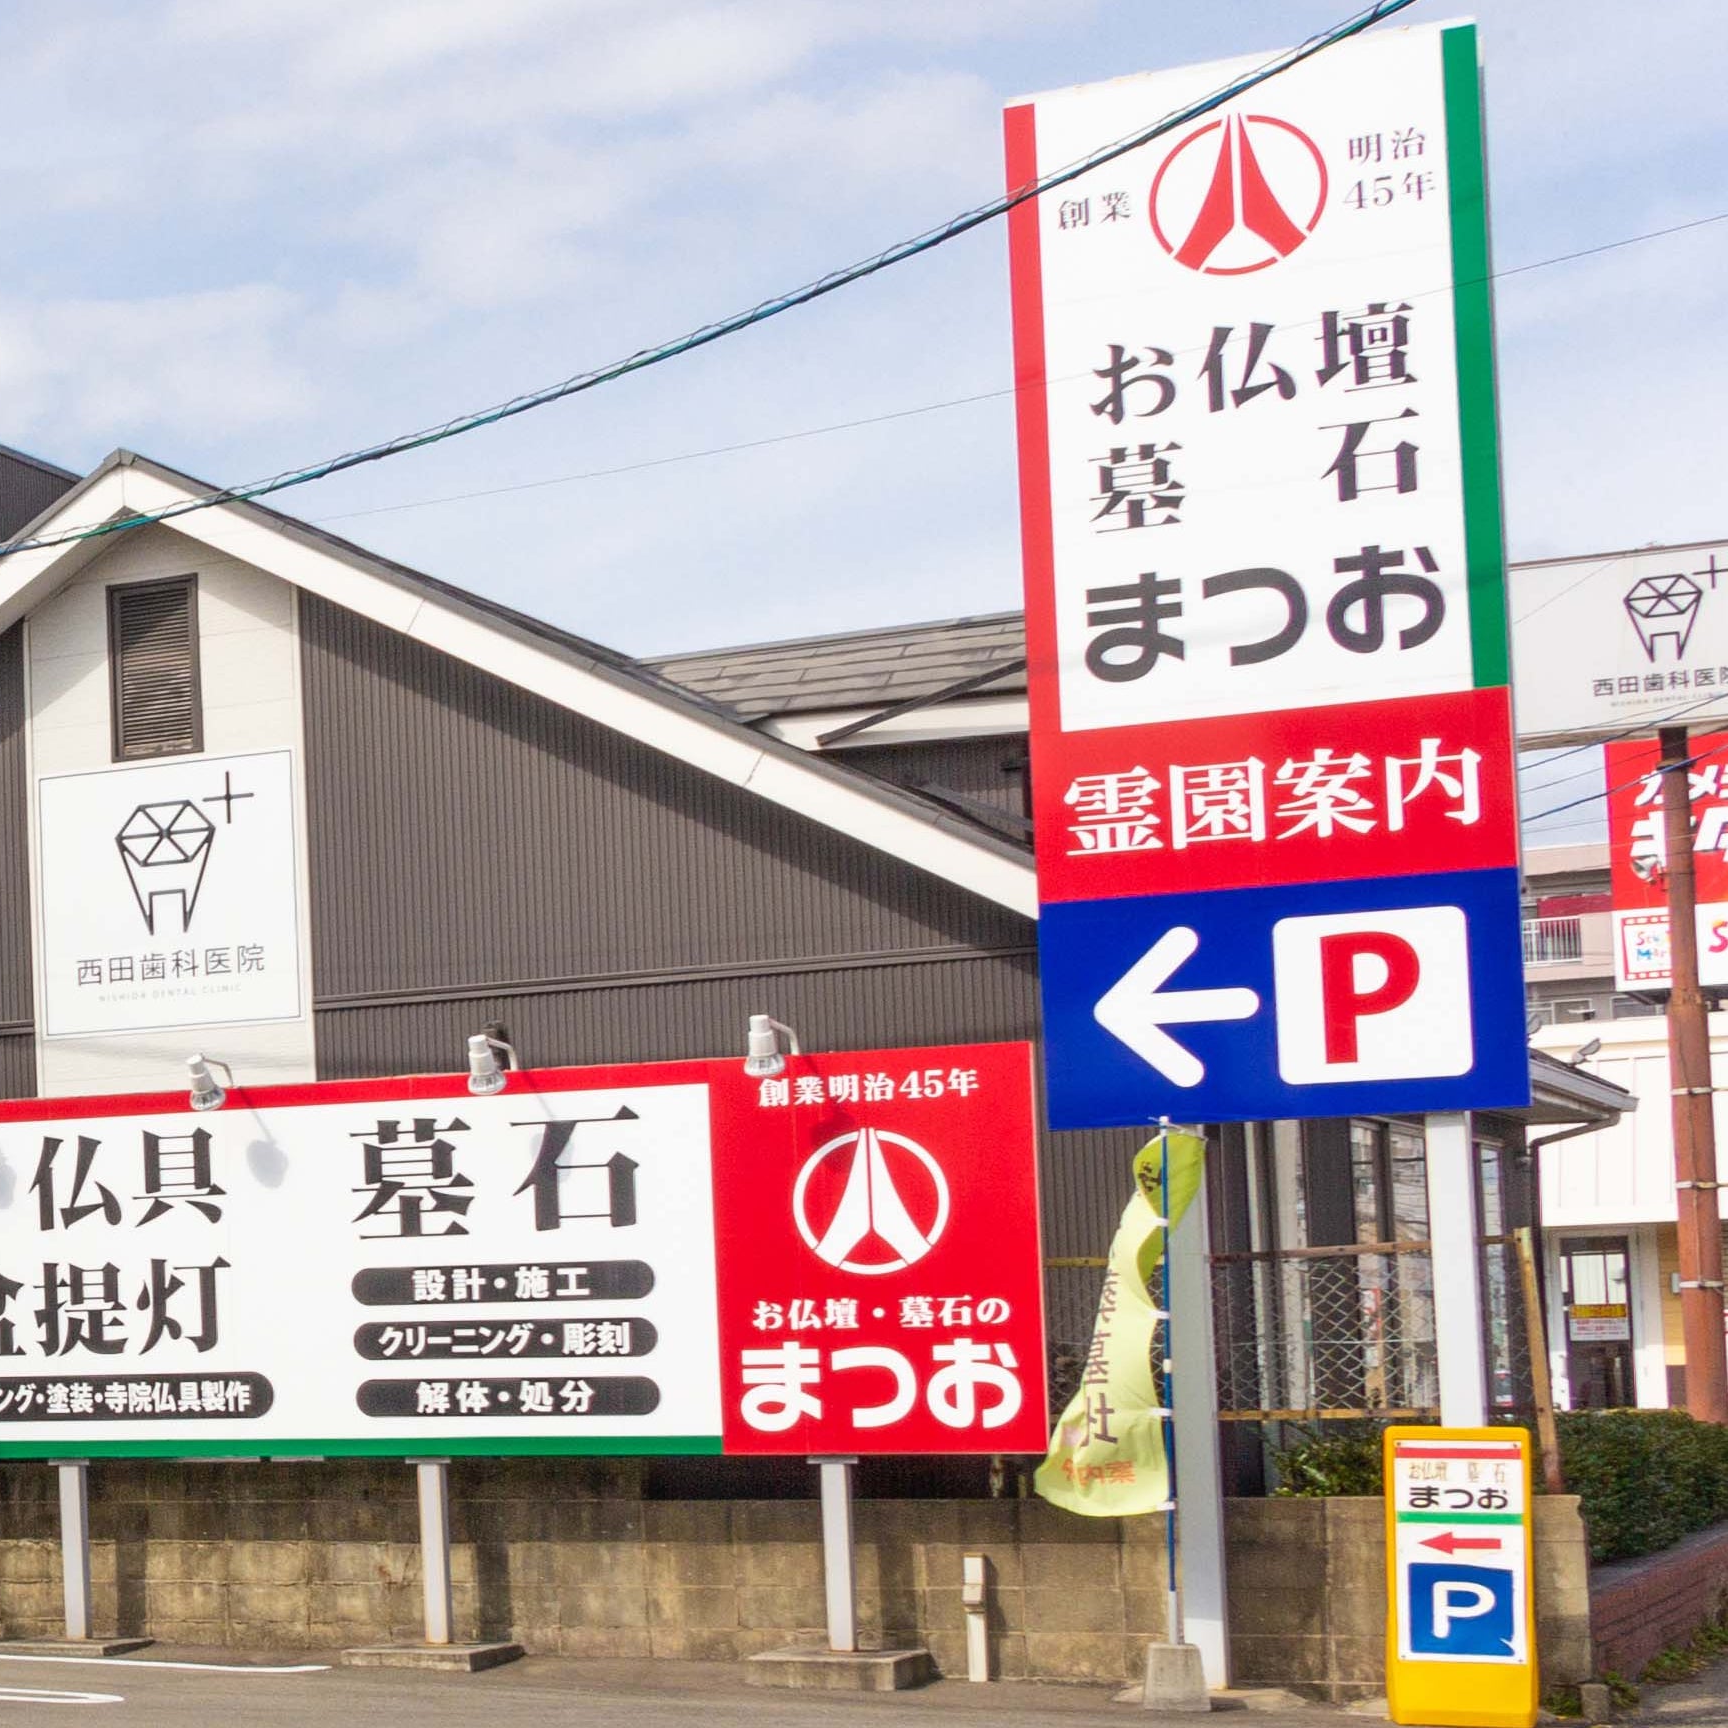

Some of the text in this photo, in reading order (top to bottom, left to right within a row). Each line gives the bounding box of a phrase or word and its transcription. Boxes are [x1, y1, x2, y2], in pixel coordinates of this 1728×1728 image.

[1348, 127, 1426, 164] 明治
[1343, 170, 1437, 210] 45年
[1058, 191, 1131, 231] 創業
[1090, 302, 1418, 426] お仏壇
[1085, 545, 1445, 683] まつお
[1063, 738, 1482, 857] 霊園案内
[77, 943, 265, 986] 西田歯科医院
[1319, 930, 1421, 1064] P
[758, 1068, 979, 1108] 創業明治45年
[349, 1105, 641, 1240] 墓石
[412, 1267, 592, 1300] 設計・施工
[753, 1297, 1011, 1330] お仏壇・墓石の
[378, 1322, 630, 1357] クリーニング・彫刻
[416, 1380, 595, 1414] 解体・処分
[740, 1337, 1022, 1432] まつお
[1409, 1486, 1508, 1510] まつお
[1433, 1581, 1495, 1638] P
